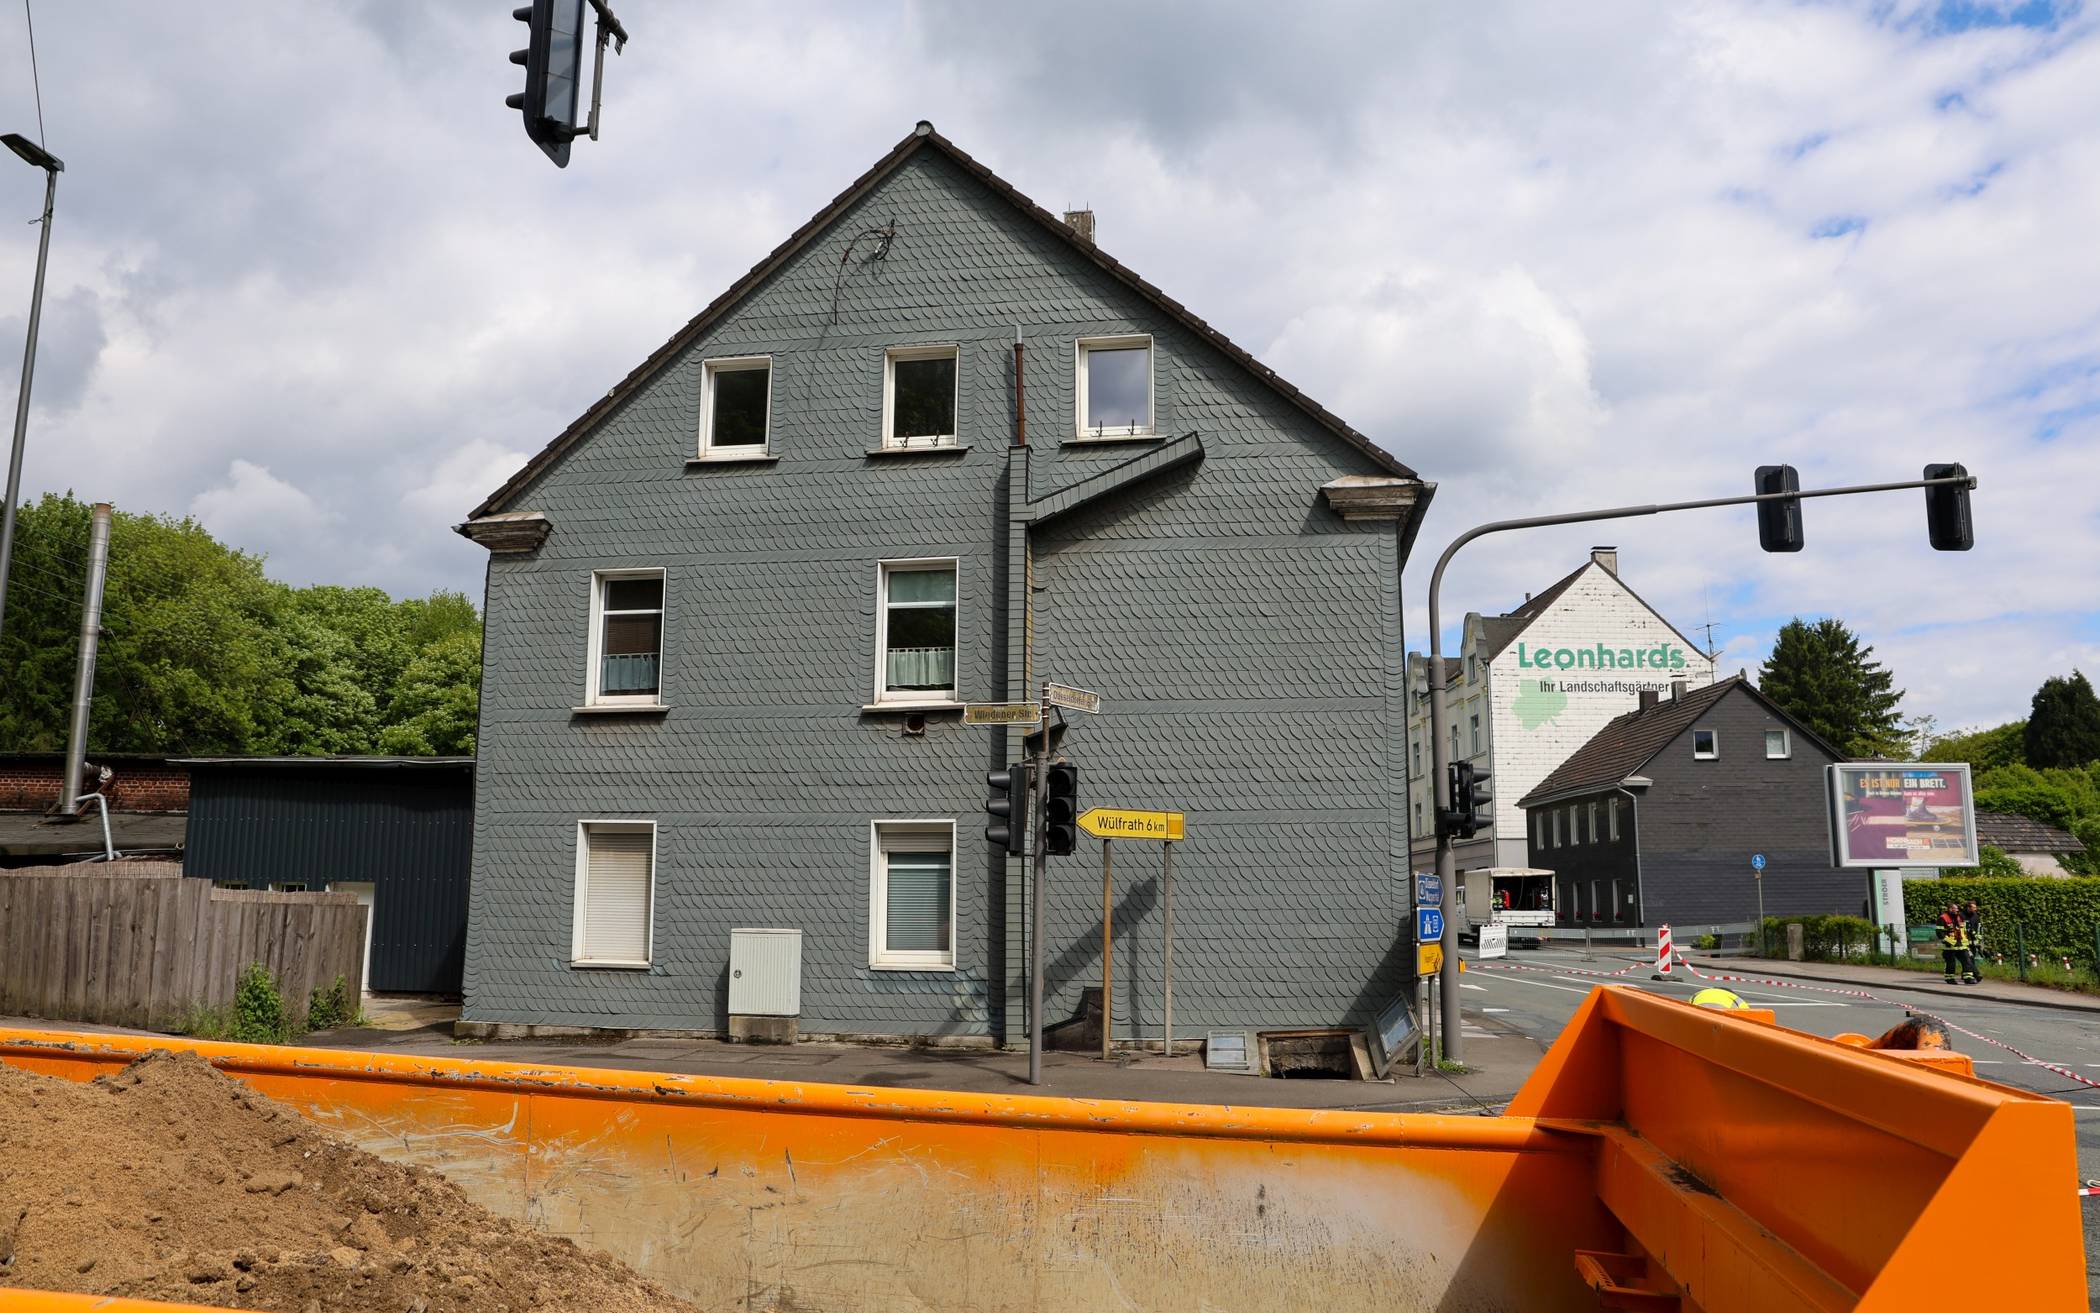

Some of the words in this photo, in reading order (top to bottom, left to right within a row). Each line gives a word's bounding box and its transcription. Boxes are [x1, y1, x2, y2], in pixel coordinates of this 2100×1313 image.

[1518, 642, 1687, 669] Leonhards
[1540, 681, 1556, 693] Ihr
[1904, 779, 1918, 788] EIN
[1919, 779, 1946, 788] BRETT.
[1098, 816, 1144, 832] Wülfrath
[1146, 819, 1153, 832] 6
[1153, 822, 1165, 832] km
